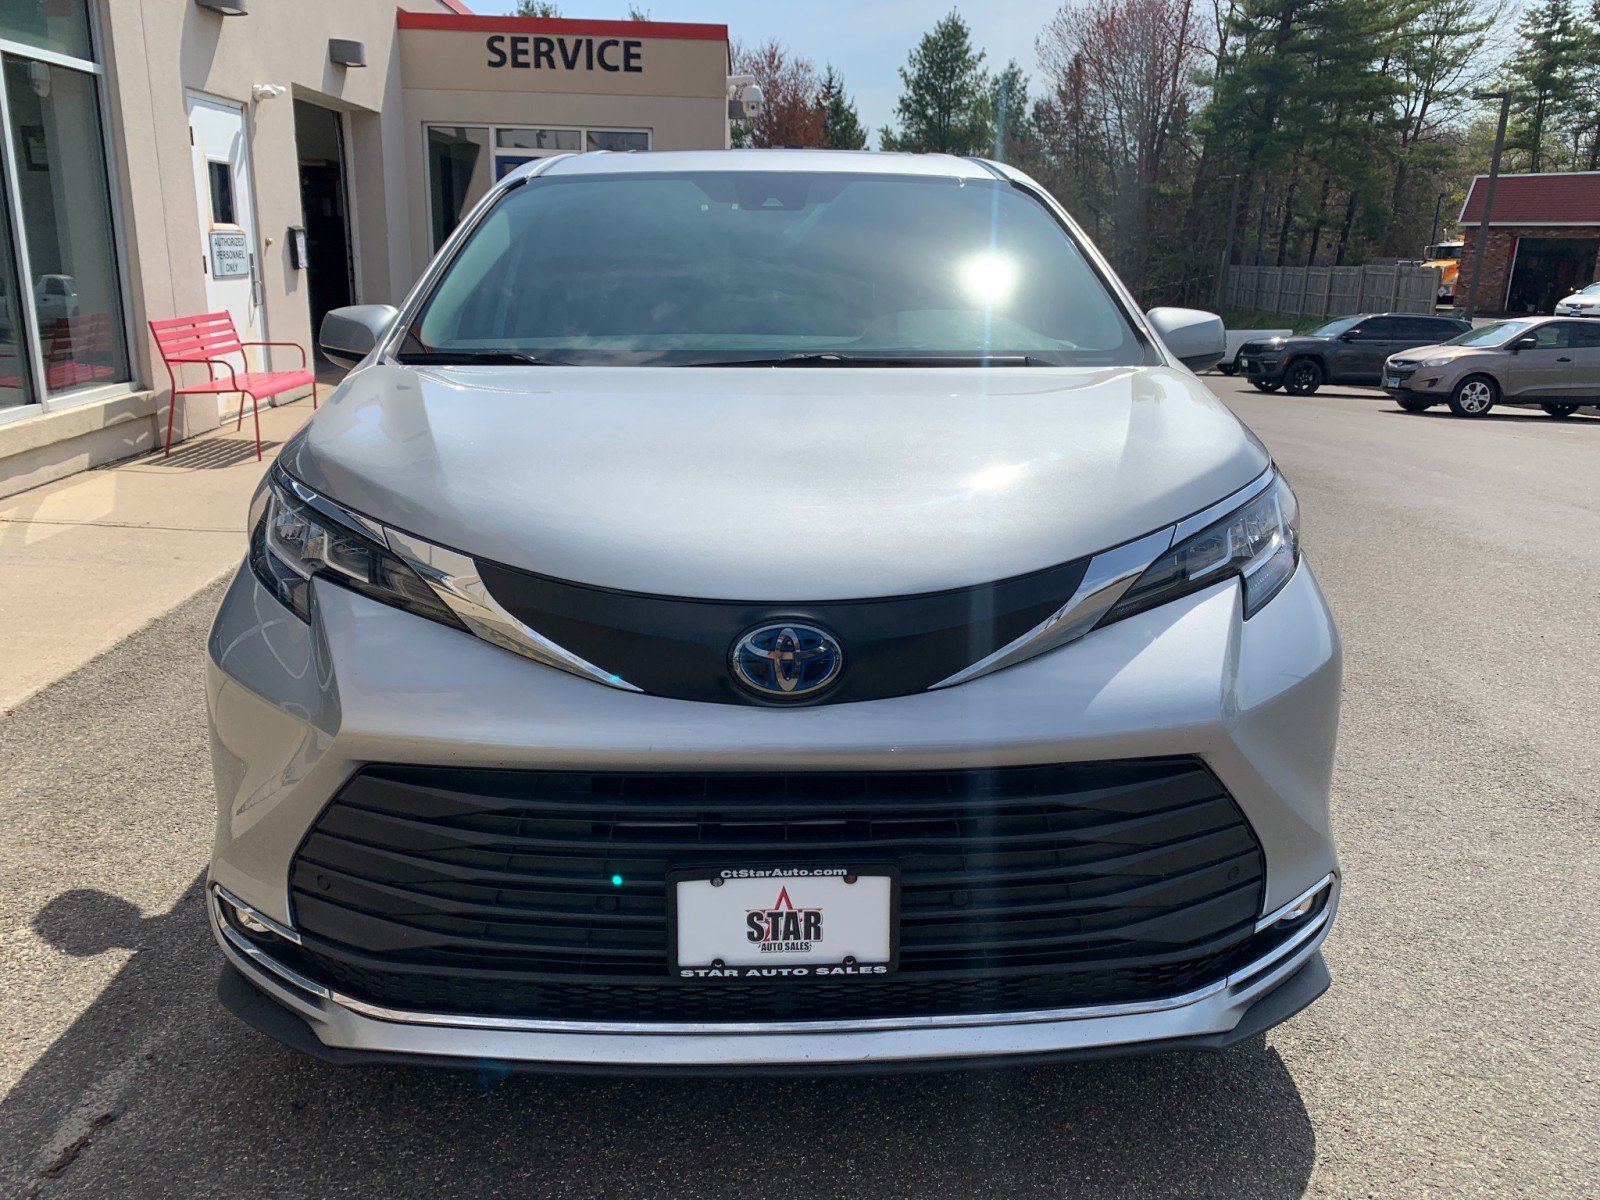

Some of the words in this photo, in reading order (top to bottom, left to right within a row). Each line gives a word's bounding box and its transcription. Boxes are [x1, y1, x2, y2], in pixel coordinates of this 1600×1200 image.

[486, 35, 643, 73] SERVICE
[214, 236, 245, 247] AUTHORIZED
[216, 250, 245, 260] PERSONNEL
[225, 263, 239, 273] ONLY
[720, 868, 848, 879] CtStarAuto.com
[746, 910, 823, 942] STAR
[760, 942, 783, 952] AUTO
[784, 941, 811, 951] SALES
[680, 969, 739, 978] STAR
[745, 968, 809, 977] AUTO
[815, 965, 888, 976] SALES
